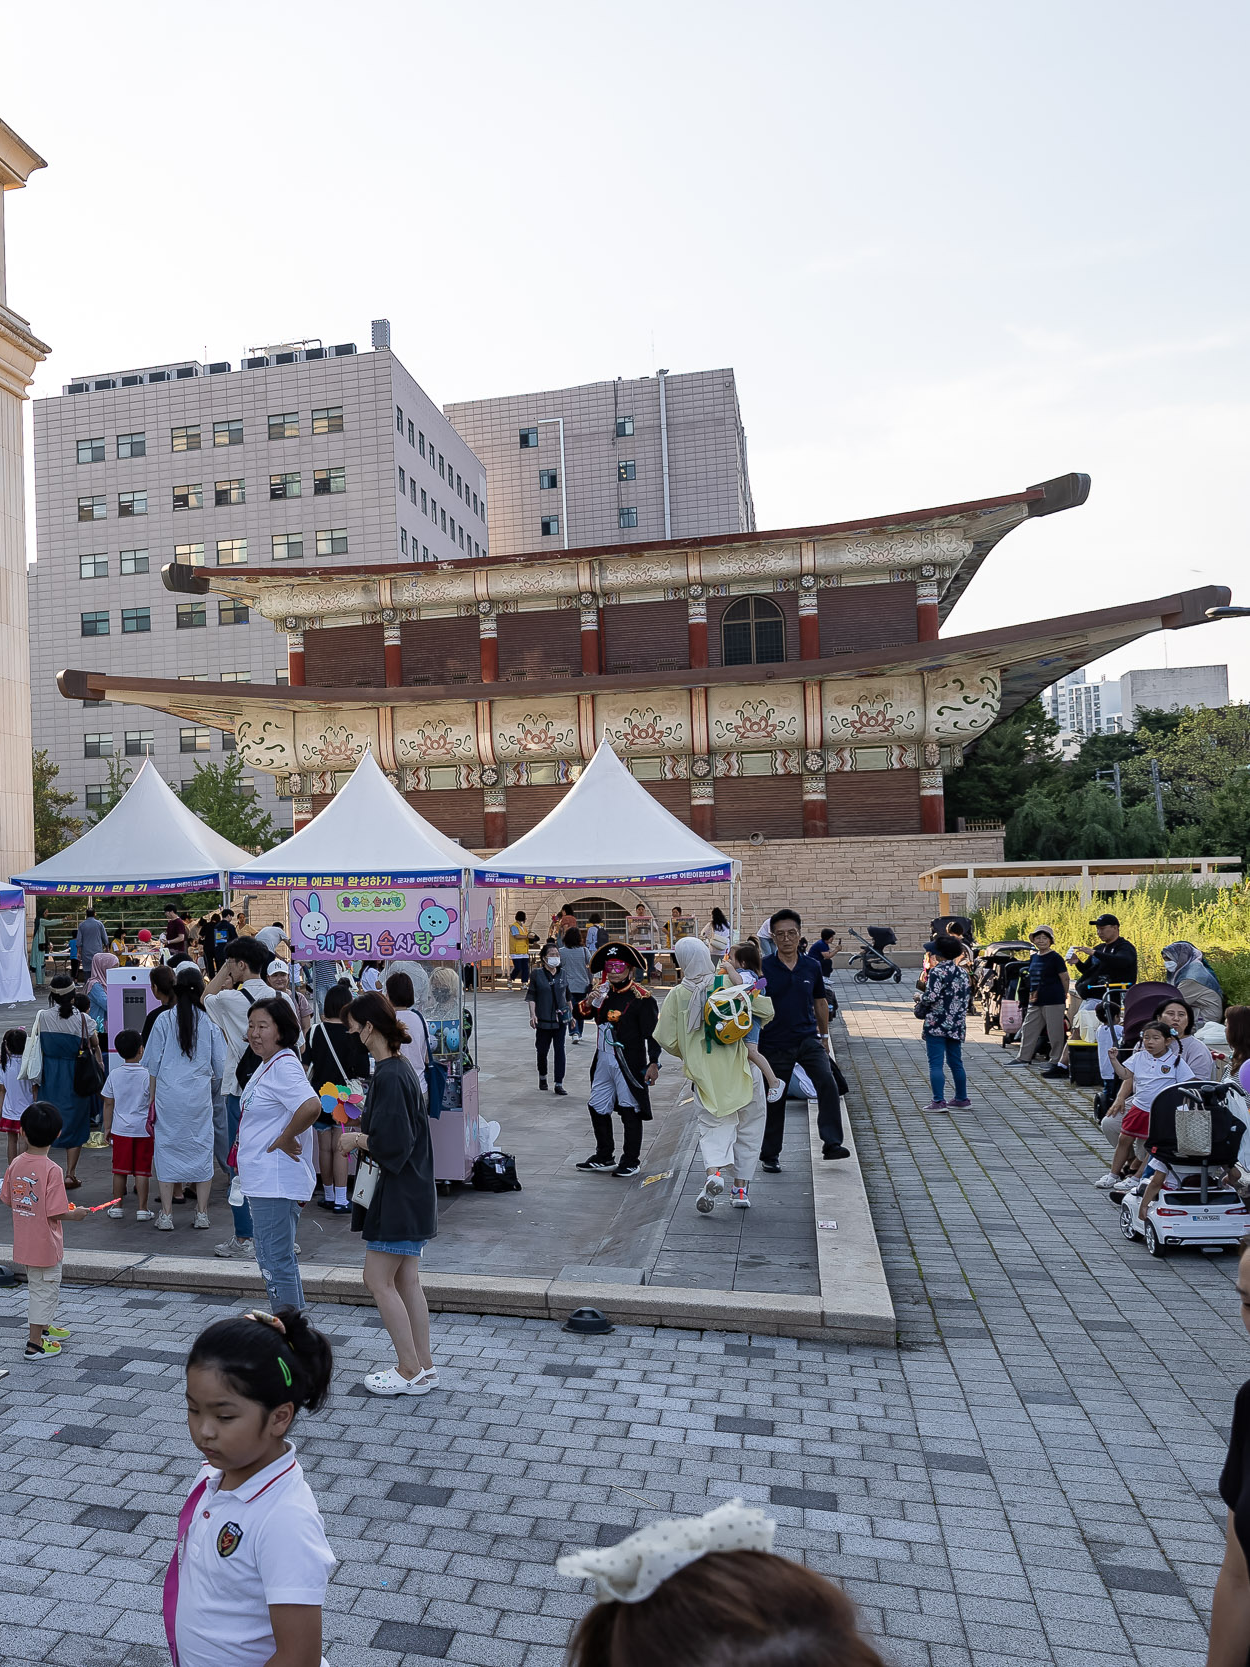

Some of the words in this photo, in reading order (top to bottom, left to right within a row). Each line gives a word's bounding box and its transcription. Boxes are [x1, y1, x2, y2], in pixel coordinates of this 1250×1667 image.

[266, 876, 307, 887] 스티커로
[311, 876, 344, 887] 에코백
[348, 875, 392, 887] 완성하기
[56, 883, 105, 893] 바람개비
[111, 883, 148, 893] 만들기
[316, 930, 372, 955] 캐릭터
[377, 929, 435, 956] 솜사탕
